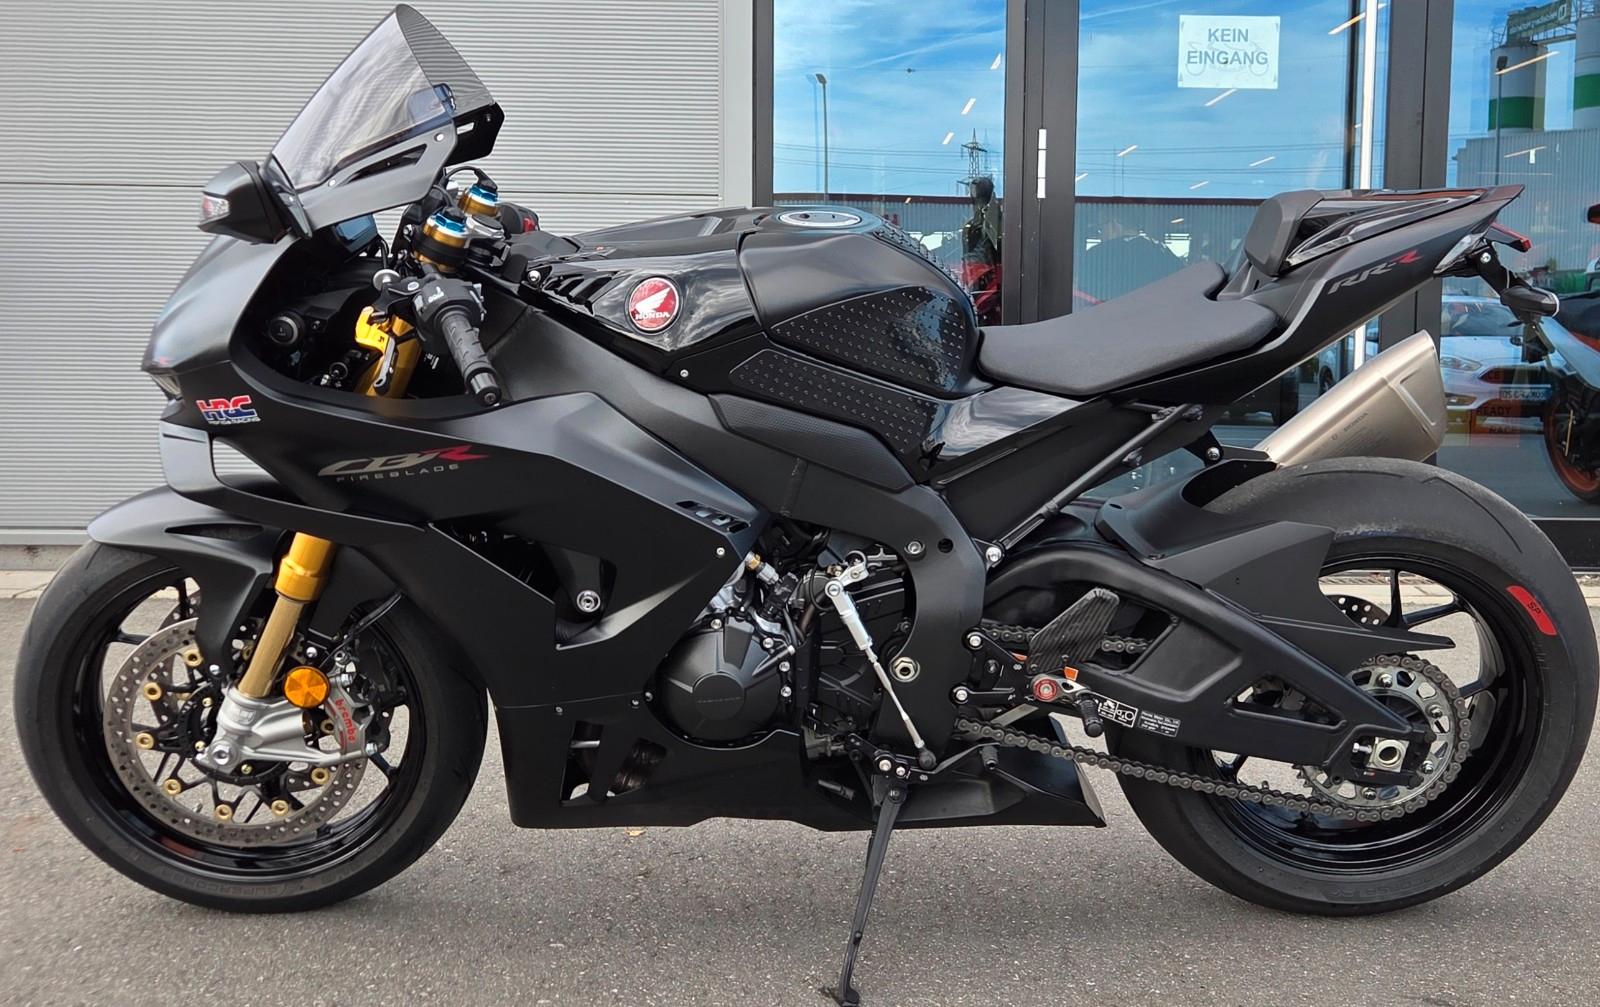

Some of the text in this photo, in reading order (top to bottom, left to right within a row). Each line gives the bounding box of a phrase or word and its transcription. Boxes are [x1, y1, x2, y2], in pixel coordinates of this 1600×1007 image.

[1208, 28, 1249, 42] KEIN
[1187, 51, 1269, 65] EINGANG
[635, 311, 671, 320] HONDA
[196, 395, 258, 421] HRC
[317, 444, 491, 477] CBR
[336, 463, 459, 483] FIREBLADE
[1527, 601, 1541, 614] SP
[335, 698, 357, 743] brembo
